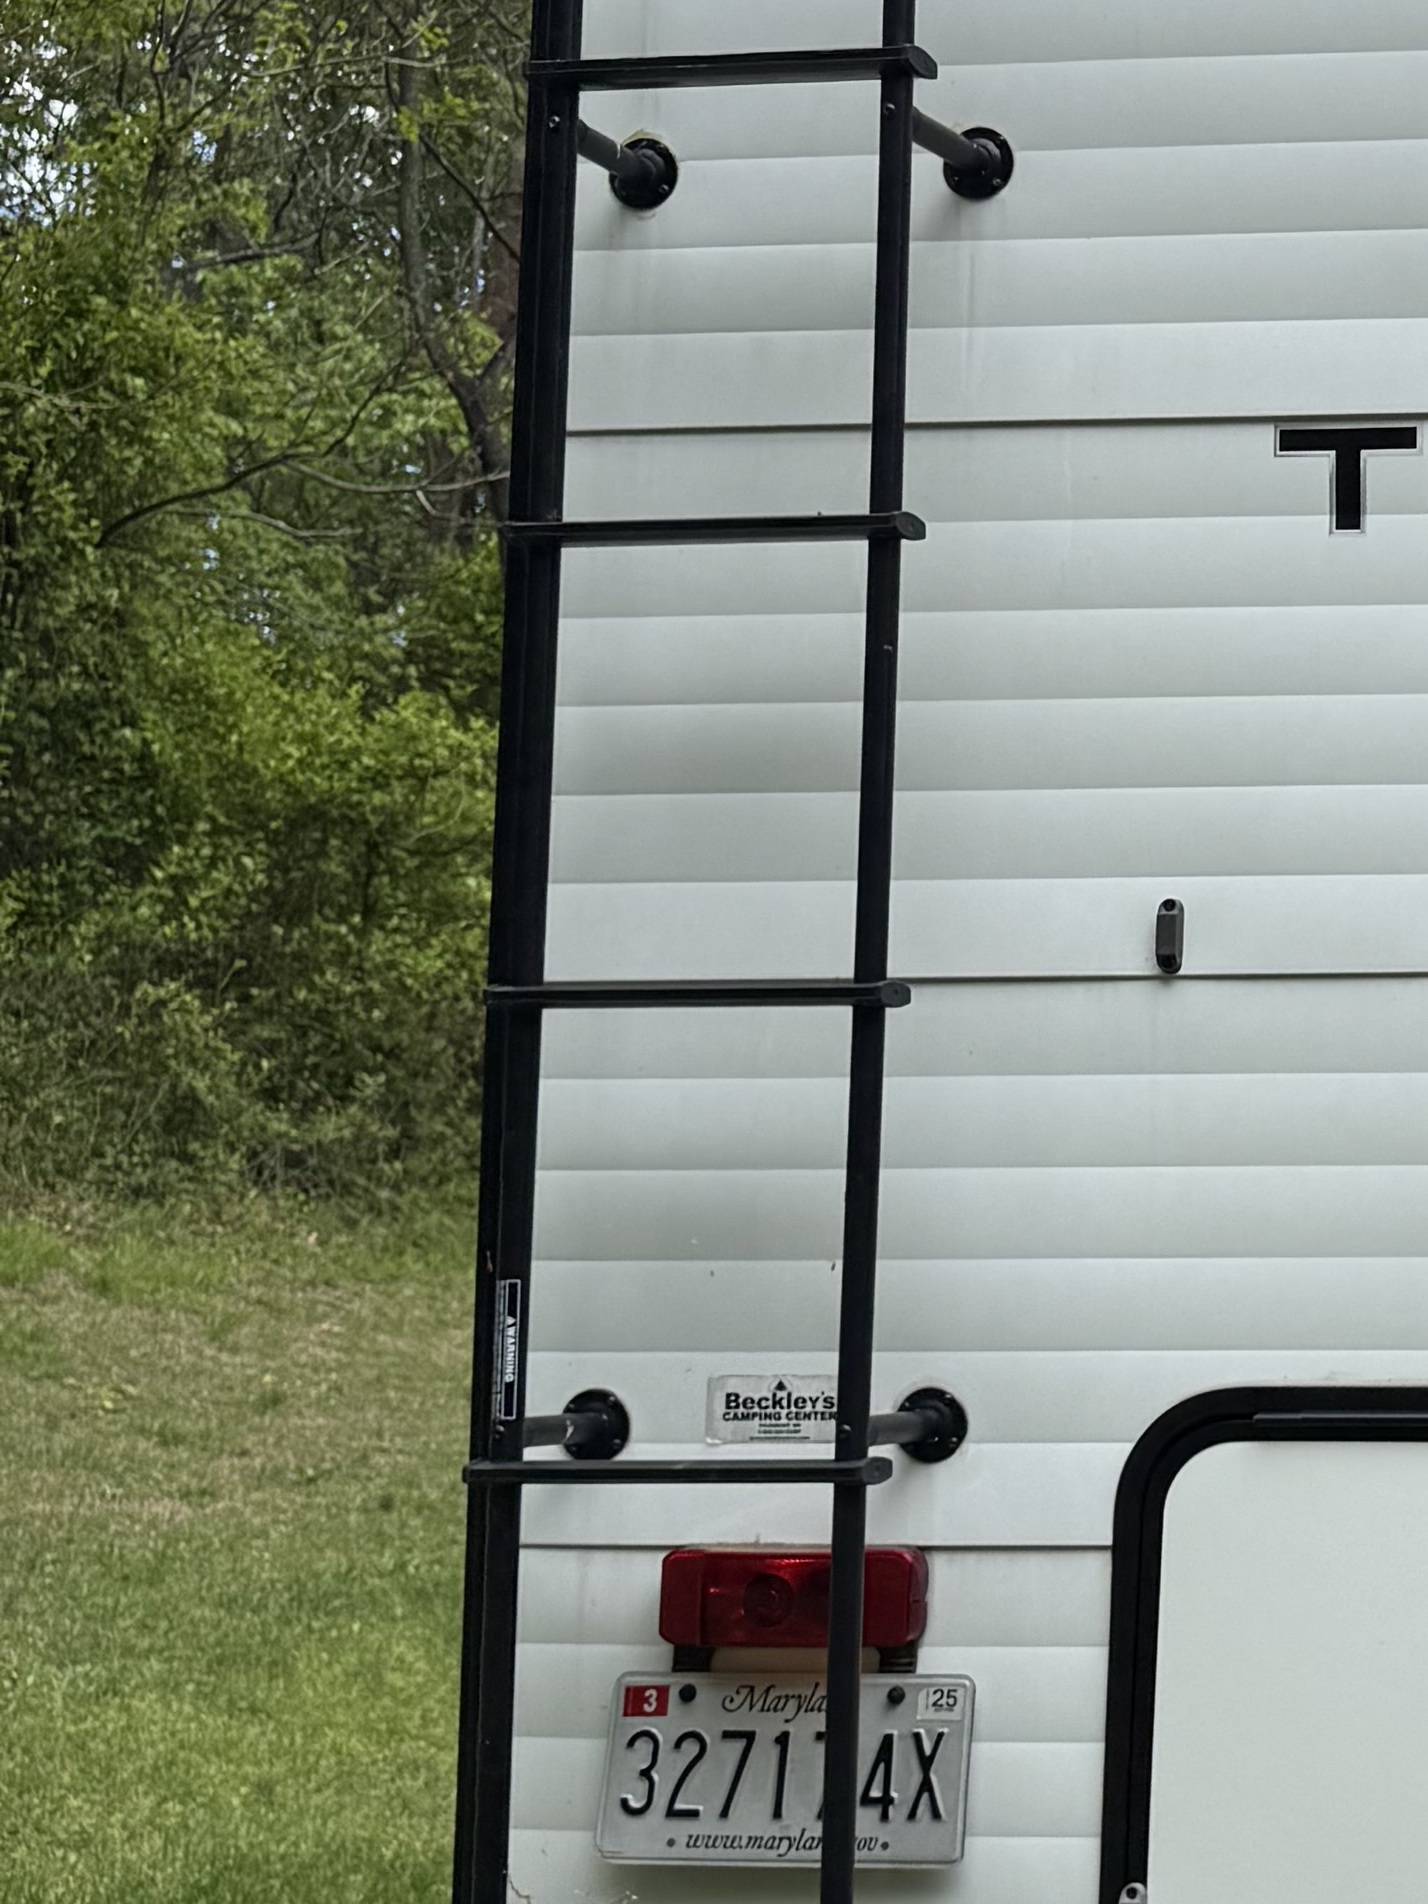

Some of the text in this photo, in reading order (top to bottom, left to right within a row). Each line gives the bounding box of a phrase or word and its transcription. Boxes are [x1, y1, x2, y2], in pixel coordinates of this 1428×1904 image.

[504, 1326, 516, 1383] WARNING
[723, 1411, 782, 1421] CAMPING
[725, 1391, 835, 1410] Beckley's
[641, 1682, 958, 1724] 3 Maryla 25
[619, 1727, 950, 1822] 32714X
